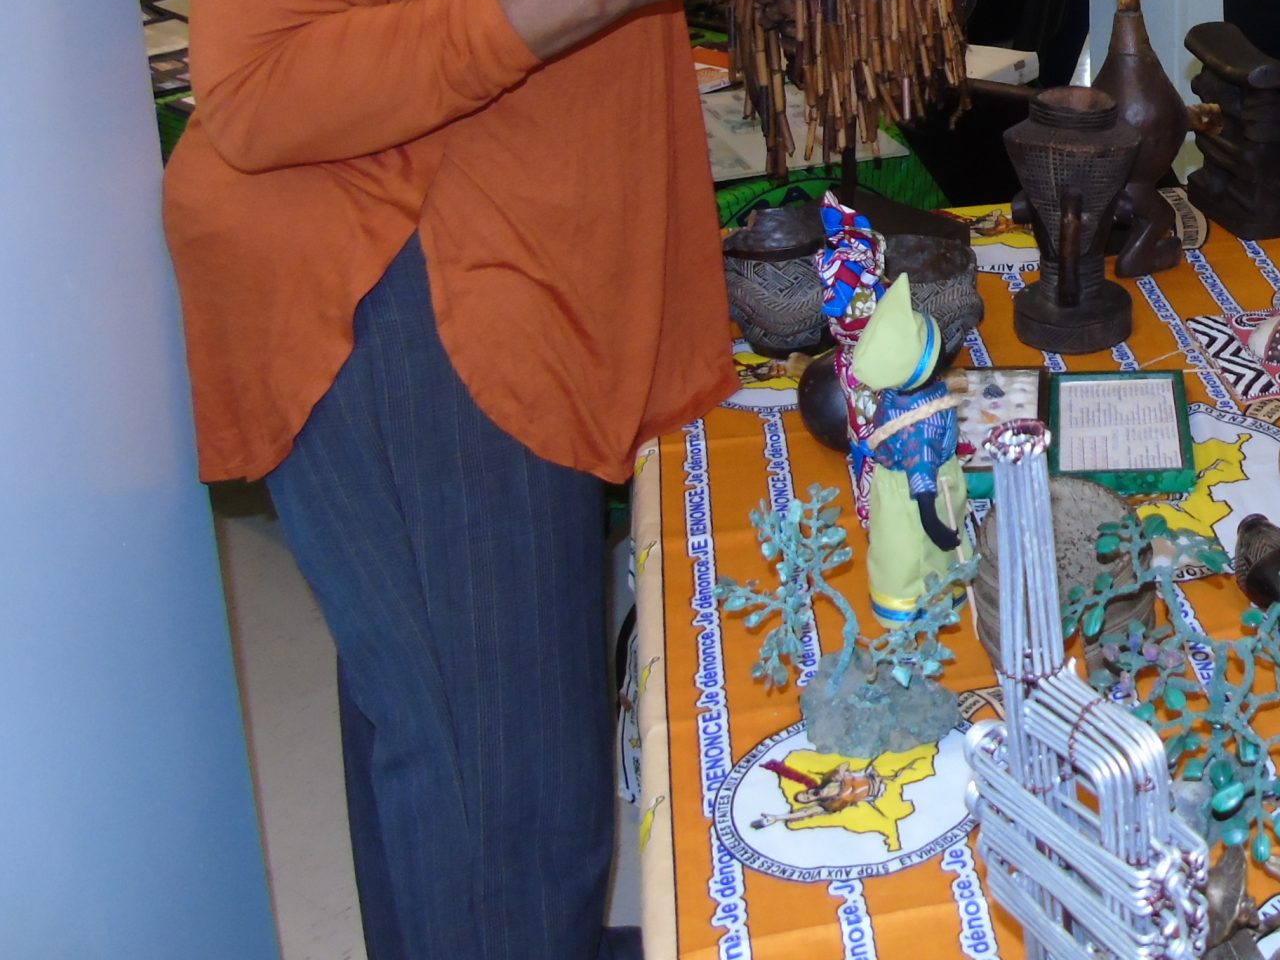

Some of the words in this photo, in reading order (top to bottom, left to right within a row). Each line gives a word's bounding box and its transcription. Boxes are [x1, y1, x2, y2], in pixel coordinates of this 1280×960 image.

[689, 472, 704, 485] Je
[691, 538, 708, 557] JE
[697, 610, 714, 625] Je
[699, 626, 718, 689] dénonce.
[701, 691, 720, 707] Je
[735, 741, 771, 775] FEMMES
[899, 854, 914, 866] ET
[945, 848, 968, 870] Je
[757, 860, 822, 881] VIOLENCES
[826, 866, 854, 879] AUX
[857, 863, 890, 877] STOP
[716, 903, 739, 924] Je
